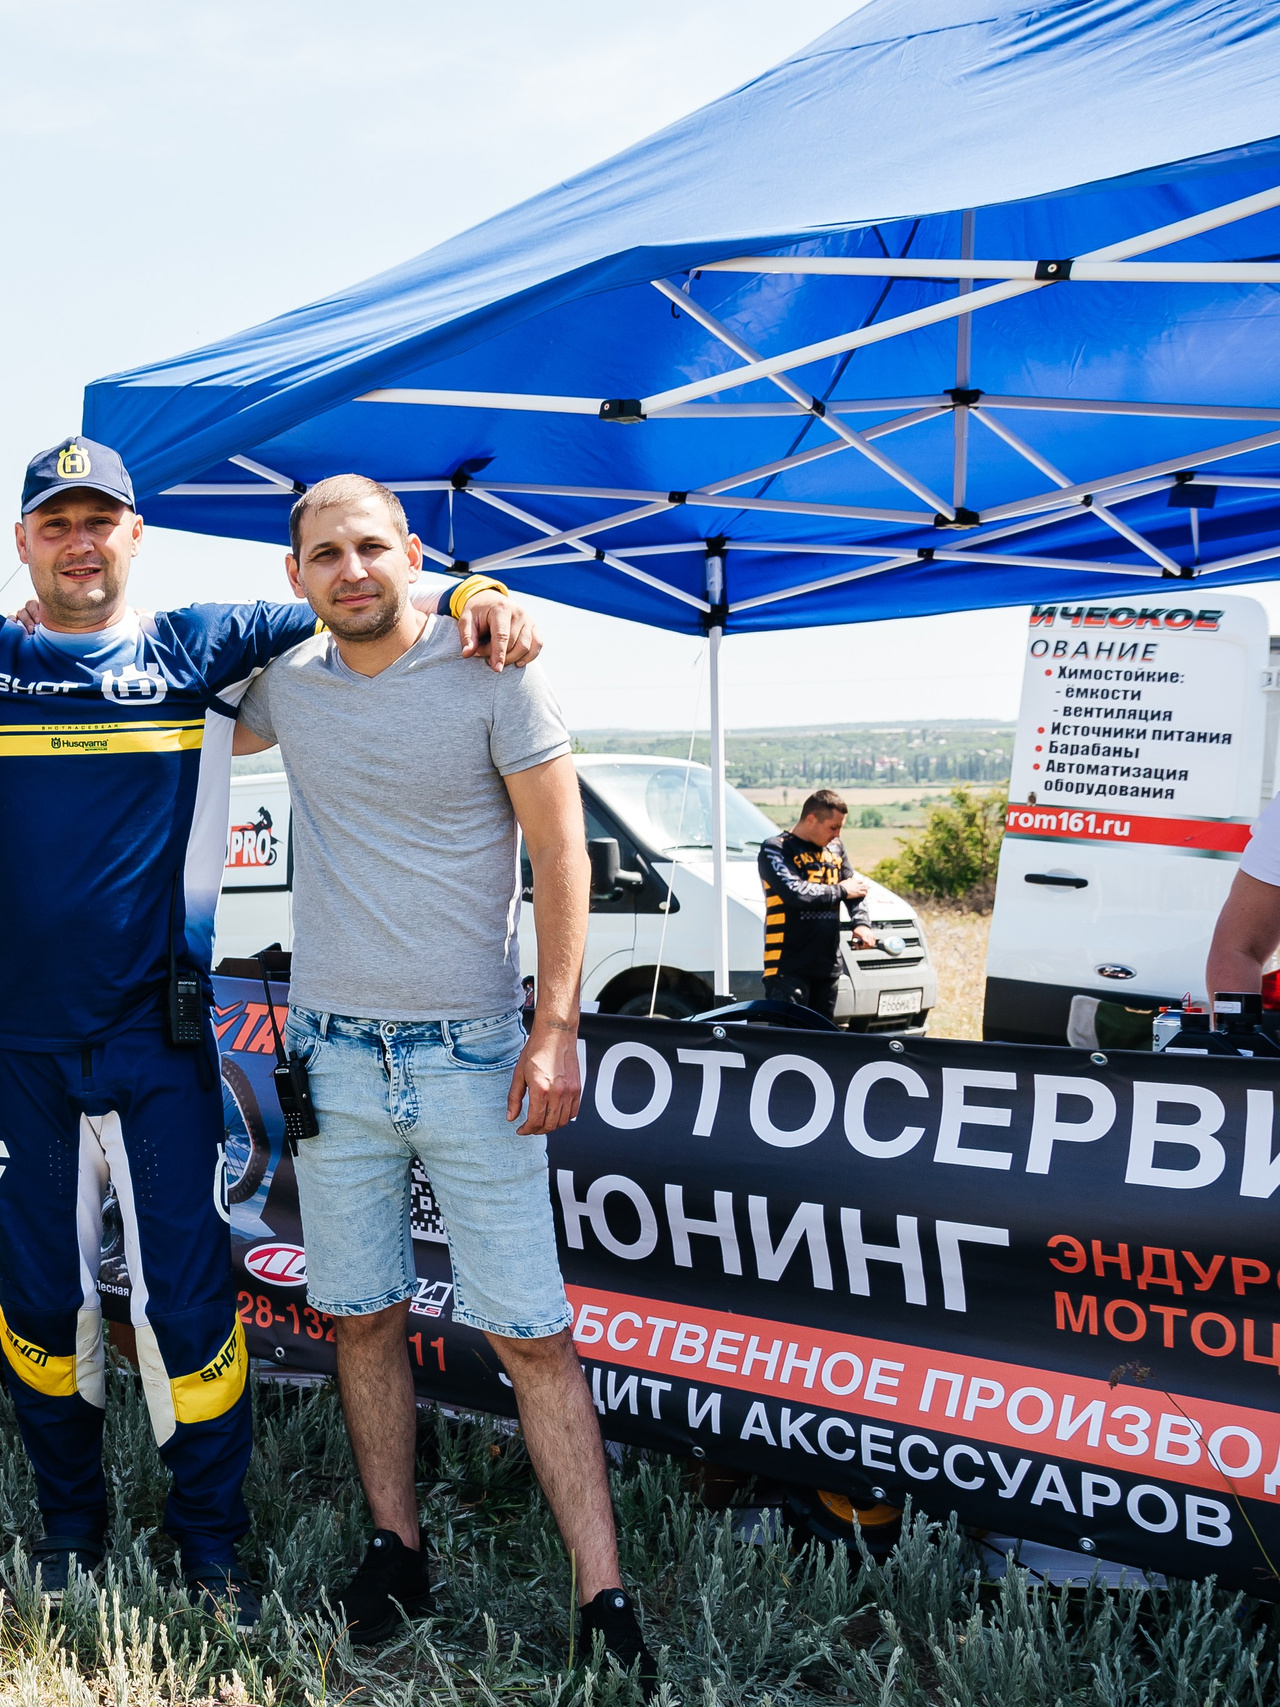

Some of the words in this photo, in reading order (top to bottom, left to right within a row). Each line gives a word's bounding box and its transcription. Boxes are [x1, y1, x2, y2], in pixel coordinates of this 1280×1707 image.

[1030, 639, 1158, 662] ОВАНИЕ
[1057, 665, 1185, 684] Химостойкие:
[1065, 683, 1142, 701] ёмкости
[1062, 705, 1173, 723] вентиляция
[62, 740, 108, 748] Husqvarna
[1051, 722, 1147, 741] Источники
[1151, 729, 1233, 745] питания
[1048, 741, 1139, 759] Барабаны
[1045, 759, 1189, 782] Автоматизация
[1044, 779, 1176, 800] оборудования
[1005, 811, 1131, 837] rom161.ru
[231, 1002, 289, 1054] TA
[570, 1038, 1280, 1199] ОТОСЕРВ
[546, 1167, 1010, 1313] ЮНИНГ
[1046, 1234, 1280, 1296] ЭНДУР
[6, 1327, 55, 1368] SHOT
[200, 1329, 238, 1383] SHOT
[566, 1301, 906, 1406] БСТВЕННОЕ
[918, 1368, 1280, 1497] ПРОИЗВО
[687, 1387, 722, 1435] И
[739, 1402, 1233, 1547] АКСЕССУАРОВ
